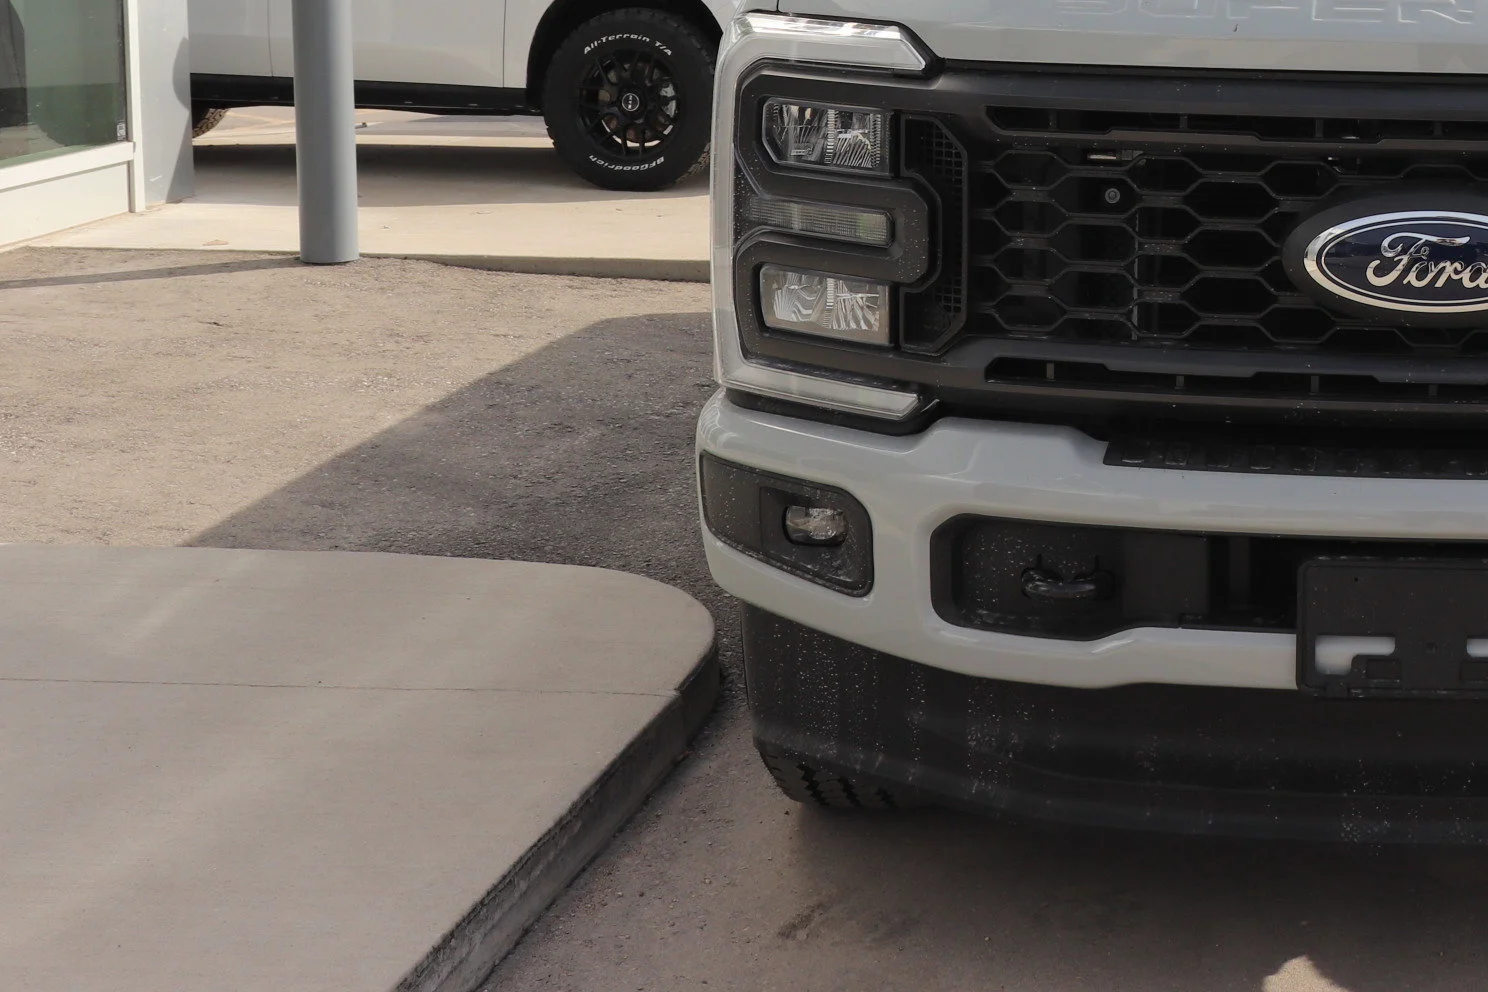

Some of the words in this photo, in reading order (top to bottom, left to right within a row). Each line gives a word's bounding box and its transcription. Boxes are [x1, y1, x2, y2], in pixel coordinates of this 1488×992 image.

[584, 34, 650, 54] All-Terrain
[655, 41, 672, 56] T/A
[589, 155, 664, 171] BFGoodrich
